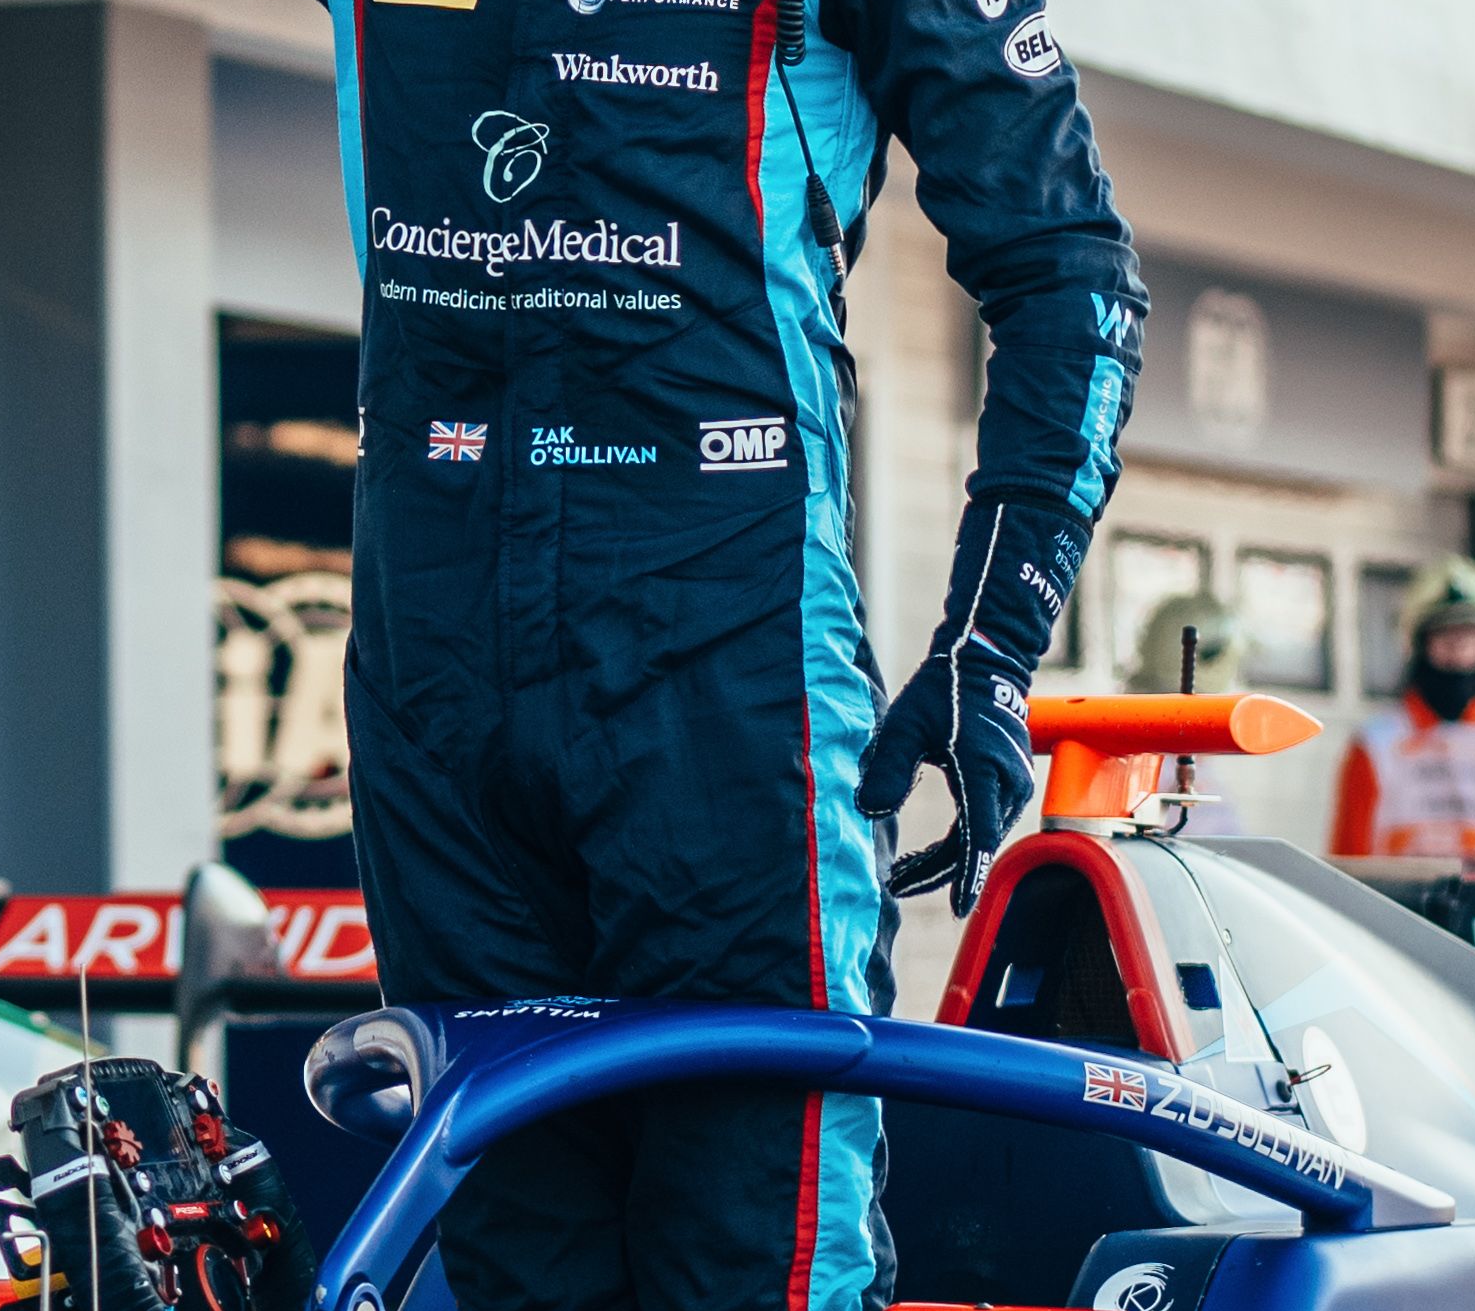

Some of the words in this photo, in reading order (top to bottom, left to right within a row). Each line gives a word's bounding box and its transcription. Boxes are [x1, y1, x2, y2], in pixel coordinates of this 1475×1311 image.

[551, 52, 719, 91] Winkworth
[371, 207, 682, 277] ConciergeMedical
[422, 285, 507, 311] medicine
[510, 288, 608, 310] traditional
[613, 290, 683, 311] values
[531, 426, 575, 445] ZAK
[700, 426, 787, 461] OMP
[530, 446, 658, 466] O'SULLIVAN
